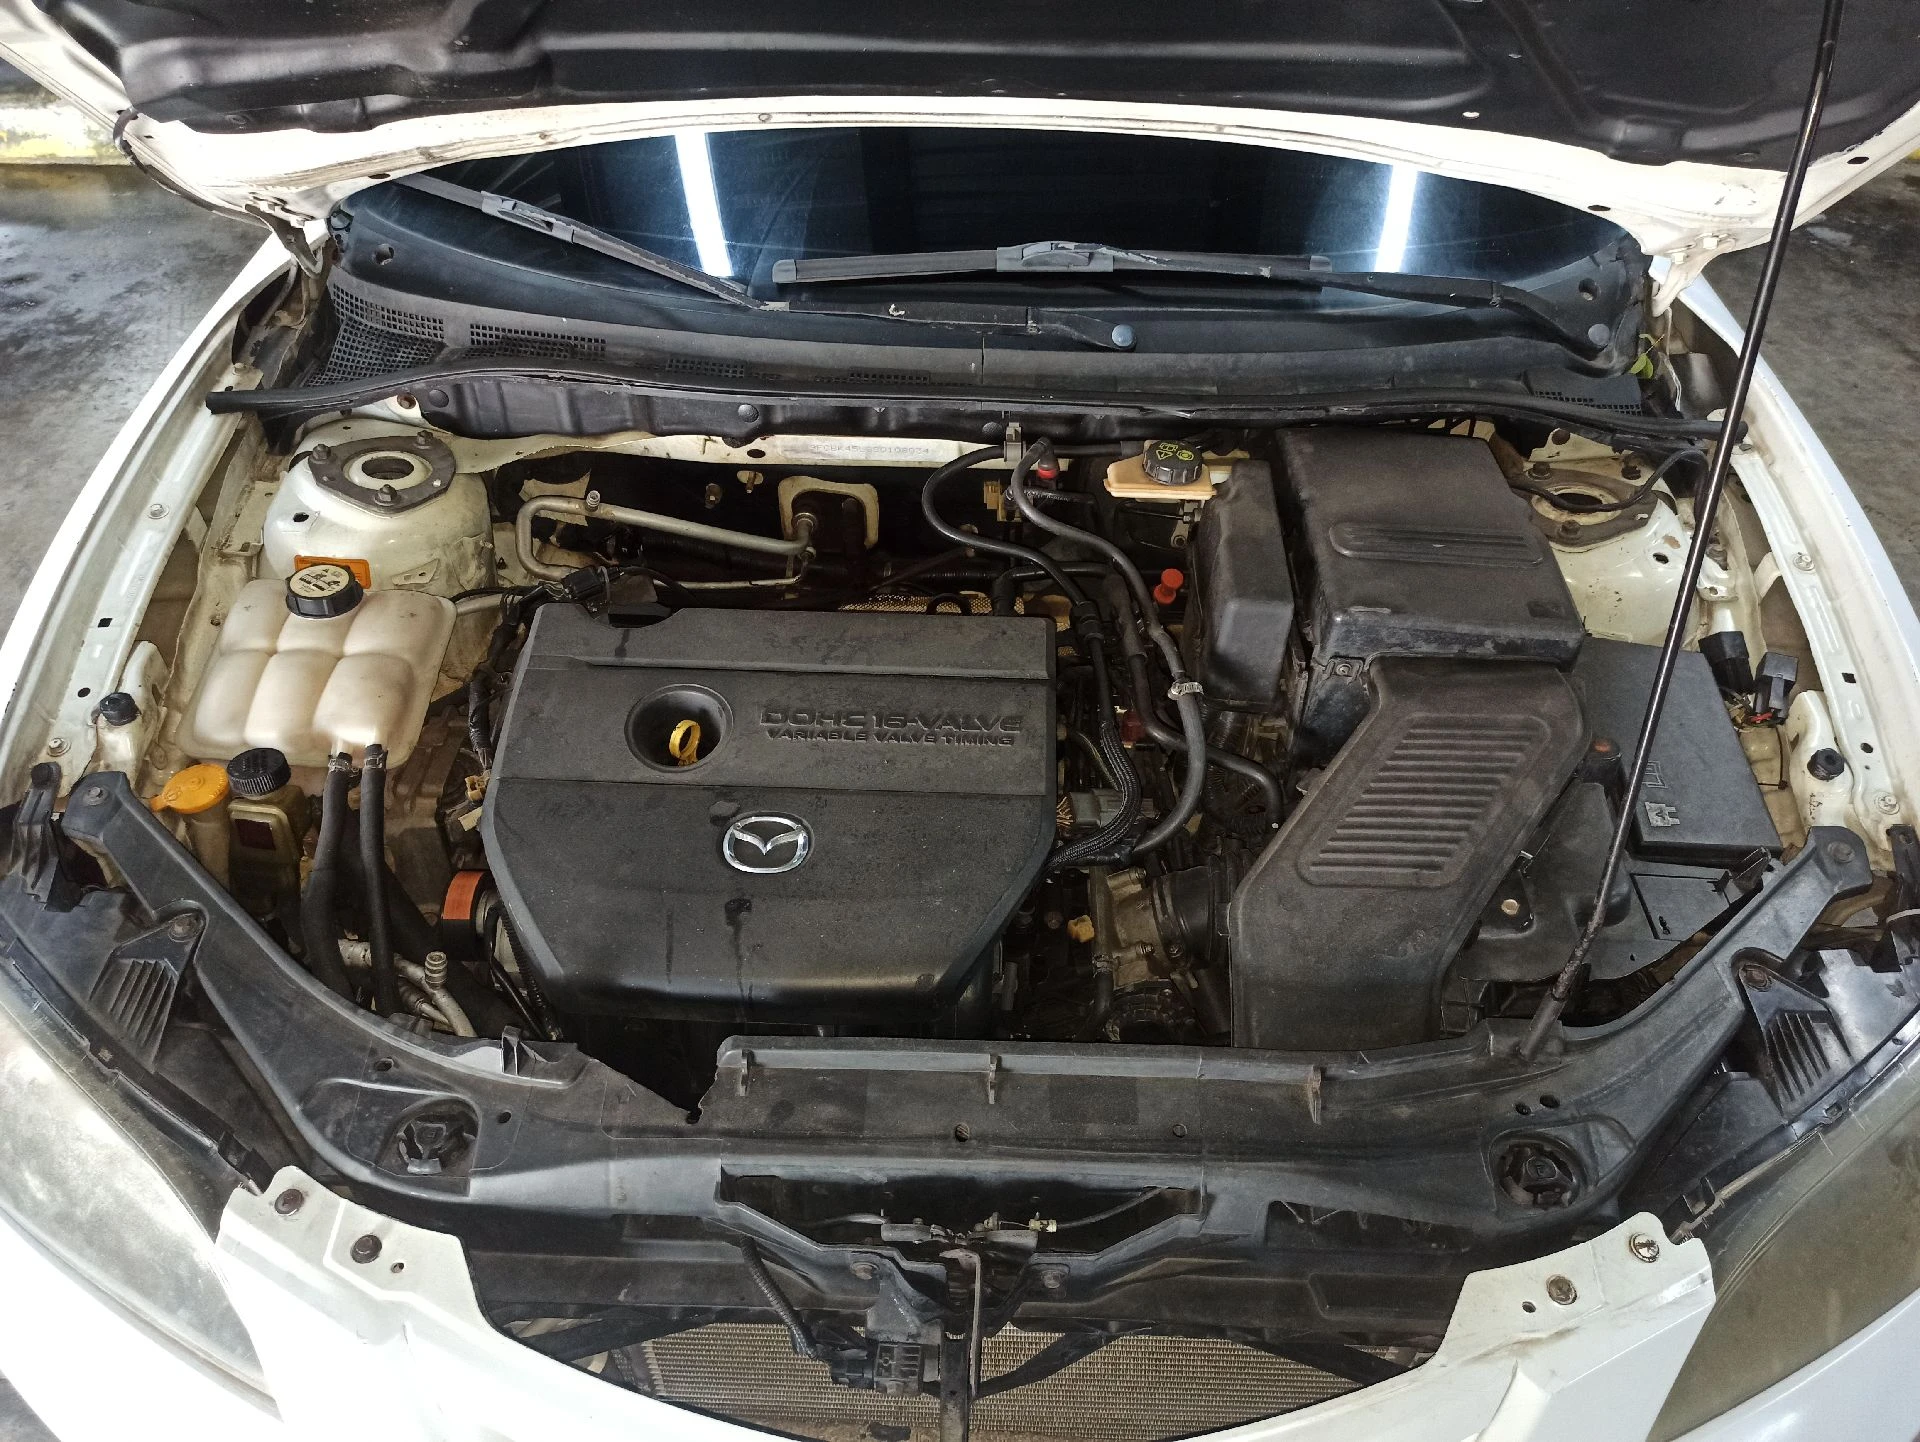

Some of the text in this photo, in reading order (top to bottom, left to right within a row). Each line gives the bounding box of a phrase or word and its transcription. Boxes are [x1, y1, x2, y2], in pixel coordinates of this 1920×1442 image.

[760, 709, 1022, 733] DOHC 16-VALVE
[766, 728, 1015, 747] VARIABLE VALVE TIMING
